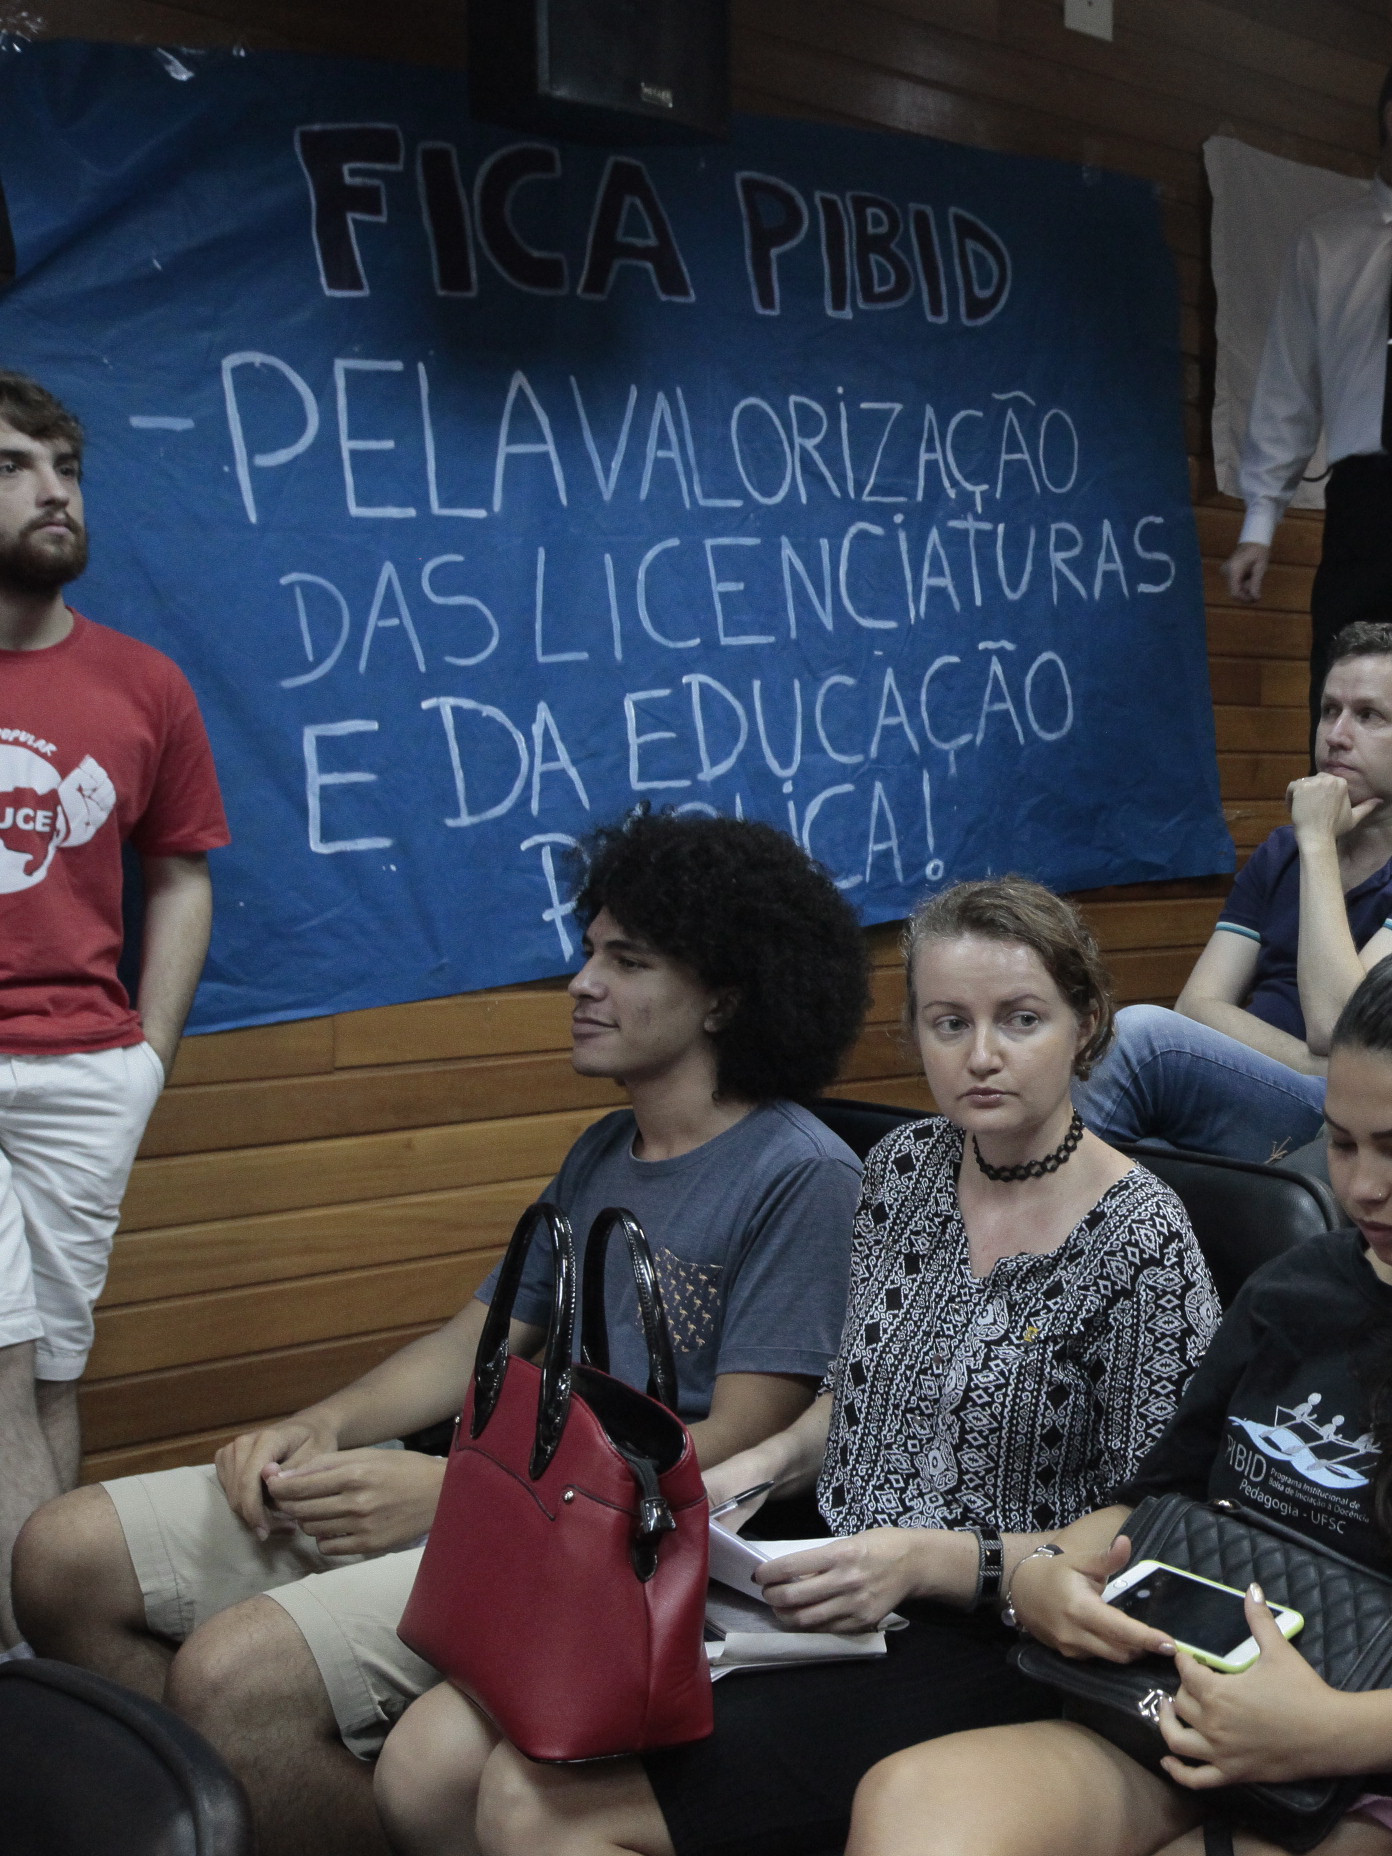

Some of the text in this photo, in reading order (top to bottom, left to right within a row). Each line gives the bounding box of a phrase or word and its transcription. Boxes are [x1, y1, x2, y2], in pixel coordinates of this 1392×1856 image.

[294, 122, 1013, 327] FICA PIBID
[221, 350, 569, 525] PELA
[279, 552, 500, 689] DAS
[0, 727, 58, 757] OPULAR
[302, 640, 1075, 855] E DA EDUCAÇÃO
[1224, 1433, 1267, 1482] PIBID
[1239, 1478, 1300, 1518] Pedagogia
[1310, 1510, 1347, 1535] UFSC
[1268, 1477, 1285, 1492] Bolsa
[1285, 1486, 1295, 1497] de
[1270, 1467, 1361, 1511] Programa Institucional de
